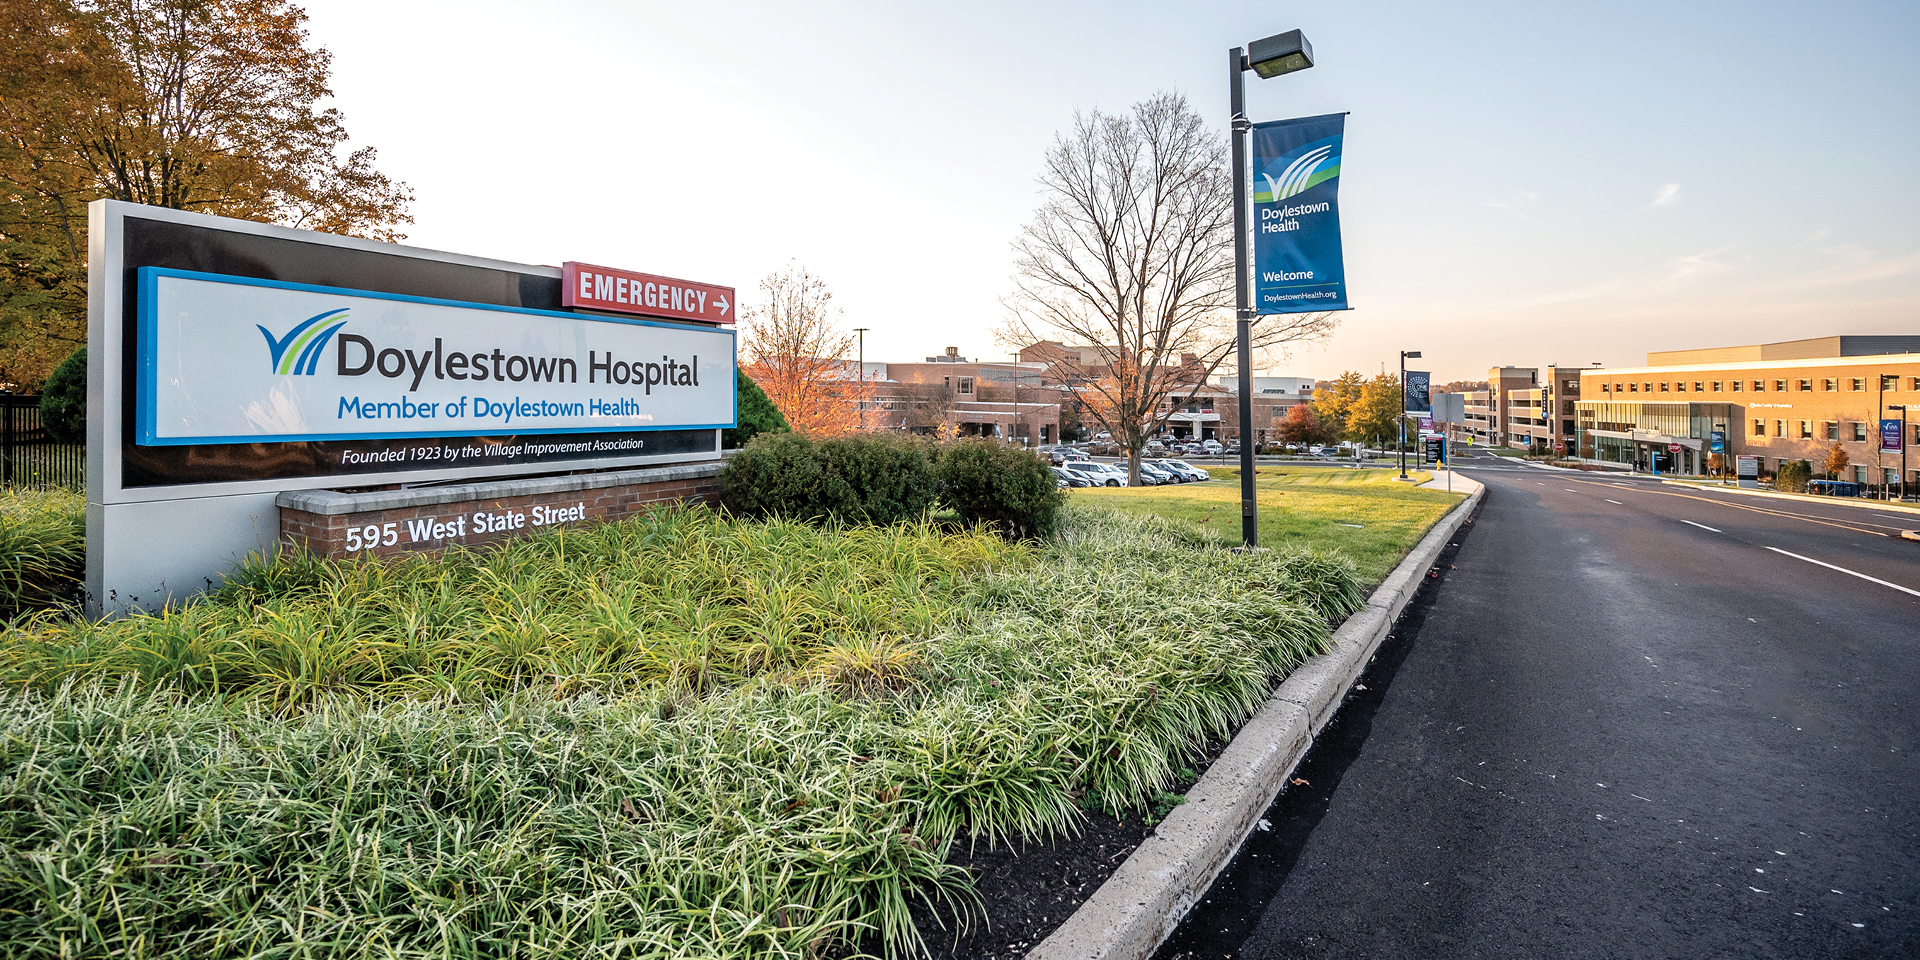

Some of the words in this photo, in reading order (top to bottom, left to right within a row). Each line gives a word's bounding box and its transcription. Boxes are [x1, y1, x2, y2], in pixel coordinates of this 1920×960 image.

[1262, 202, 1329, 221] Doylestown
[1262, 218, 1299, 233] Health
[1262, 270, 1314, 282] Welcome
[579, 273, 707, 314] EMERGENCY
[1264, 291, 1337, 303] DoylestownHealth.org
[337, 333, 577, 392] Doylestown
[589, 350, 699, 395] Hospital
[337, 396, 439, 419] Member
[445, 396, 467, 418] of
[473, 397, 584, 423] Doylestown
[589, 398, 640, 416] Health
[342, 449, 406, 464] Founded
[409, 447, 441, 461] 1923
[444, 446, 459, 460] by
[462, 445, 482, 458] the
[484, 443, 522, 458] Village
[524, 441, 591, 457] Improvement
[593, 438, 644, 451] Association
[345, 523, 399, 552] 595
[408, 515, 466, 543] West
[472, 511, 525, 534] State
[531, 502, 586, 526] Street
